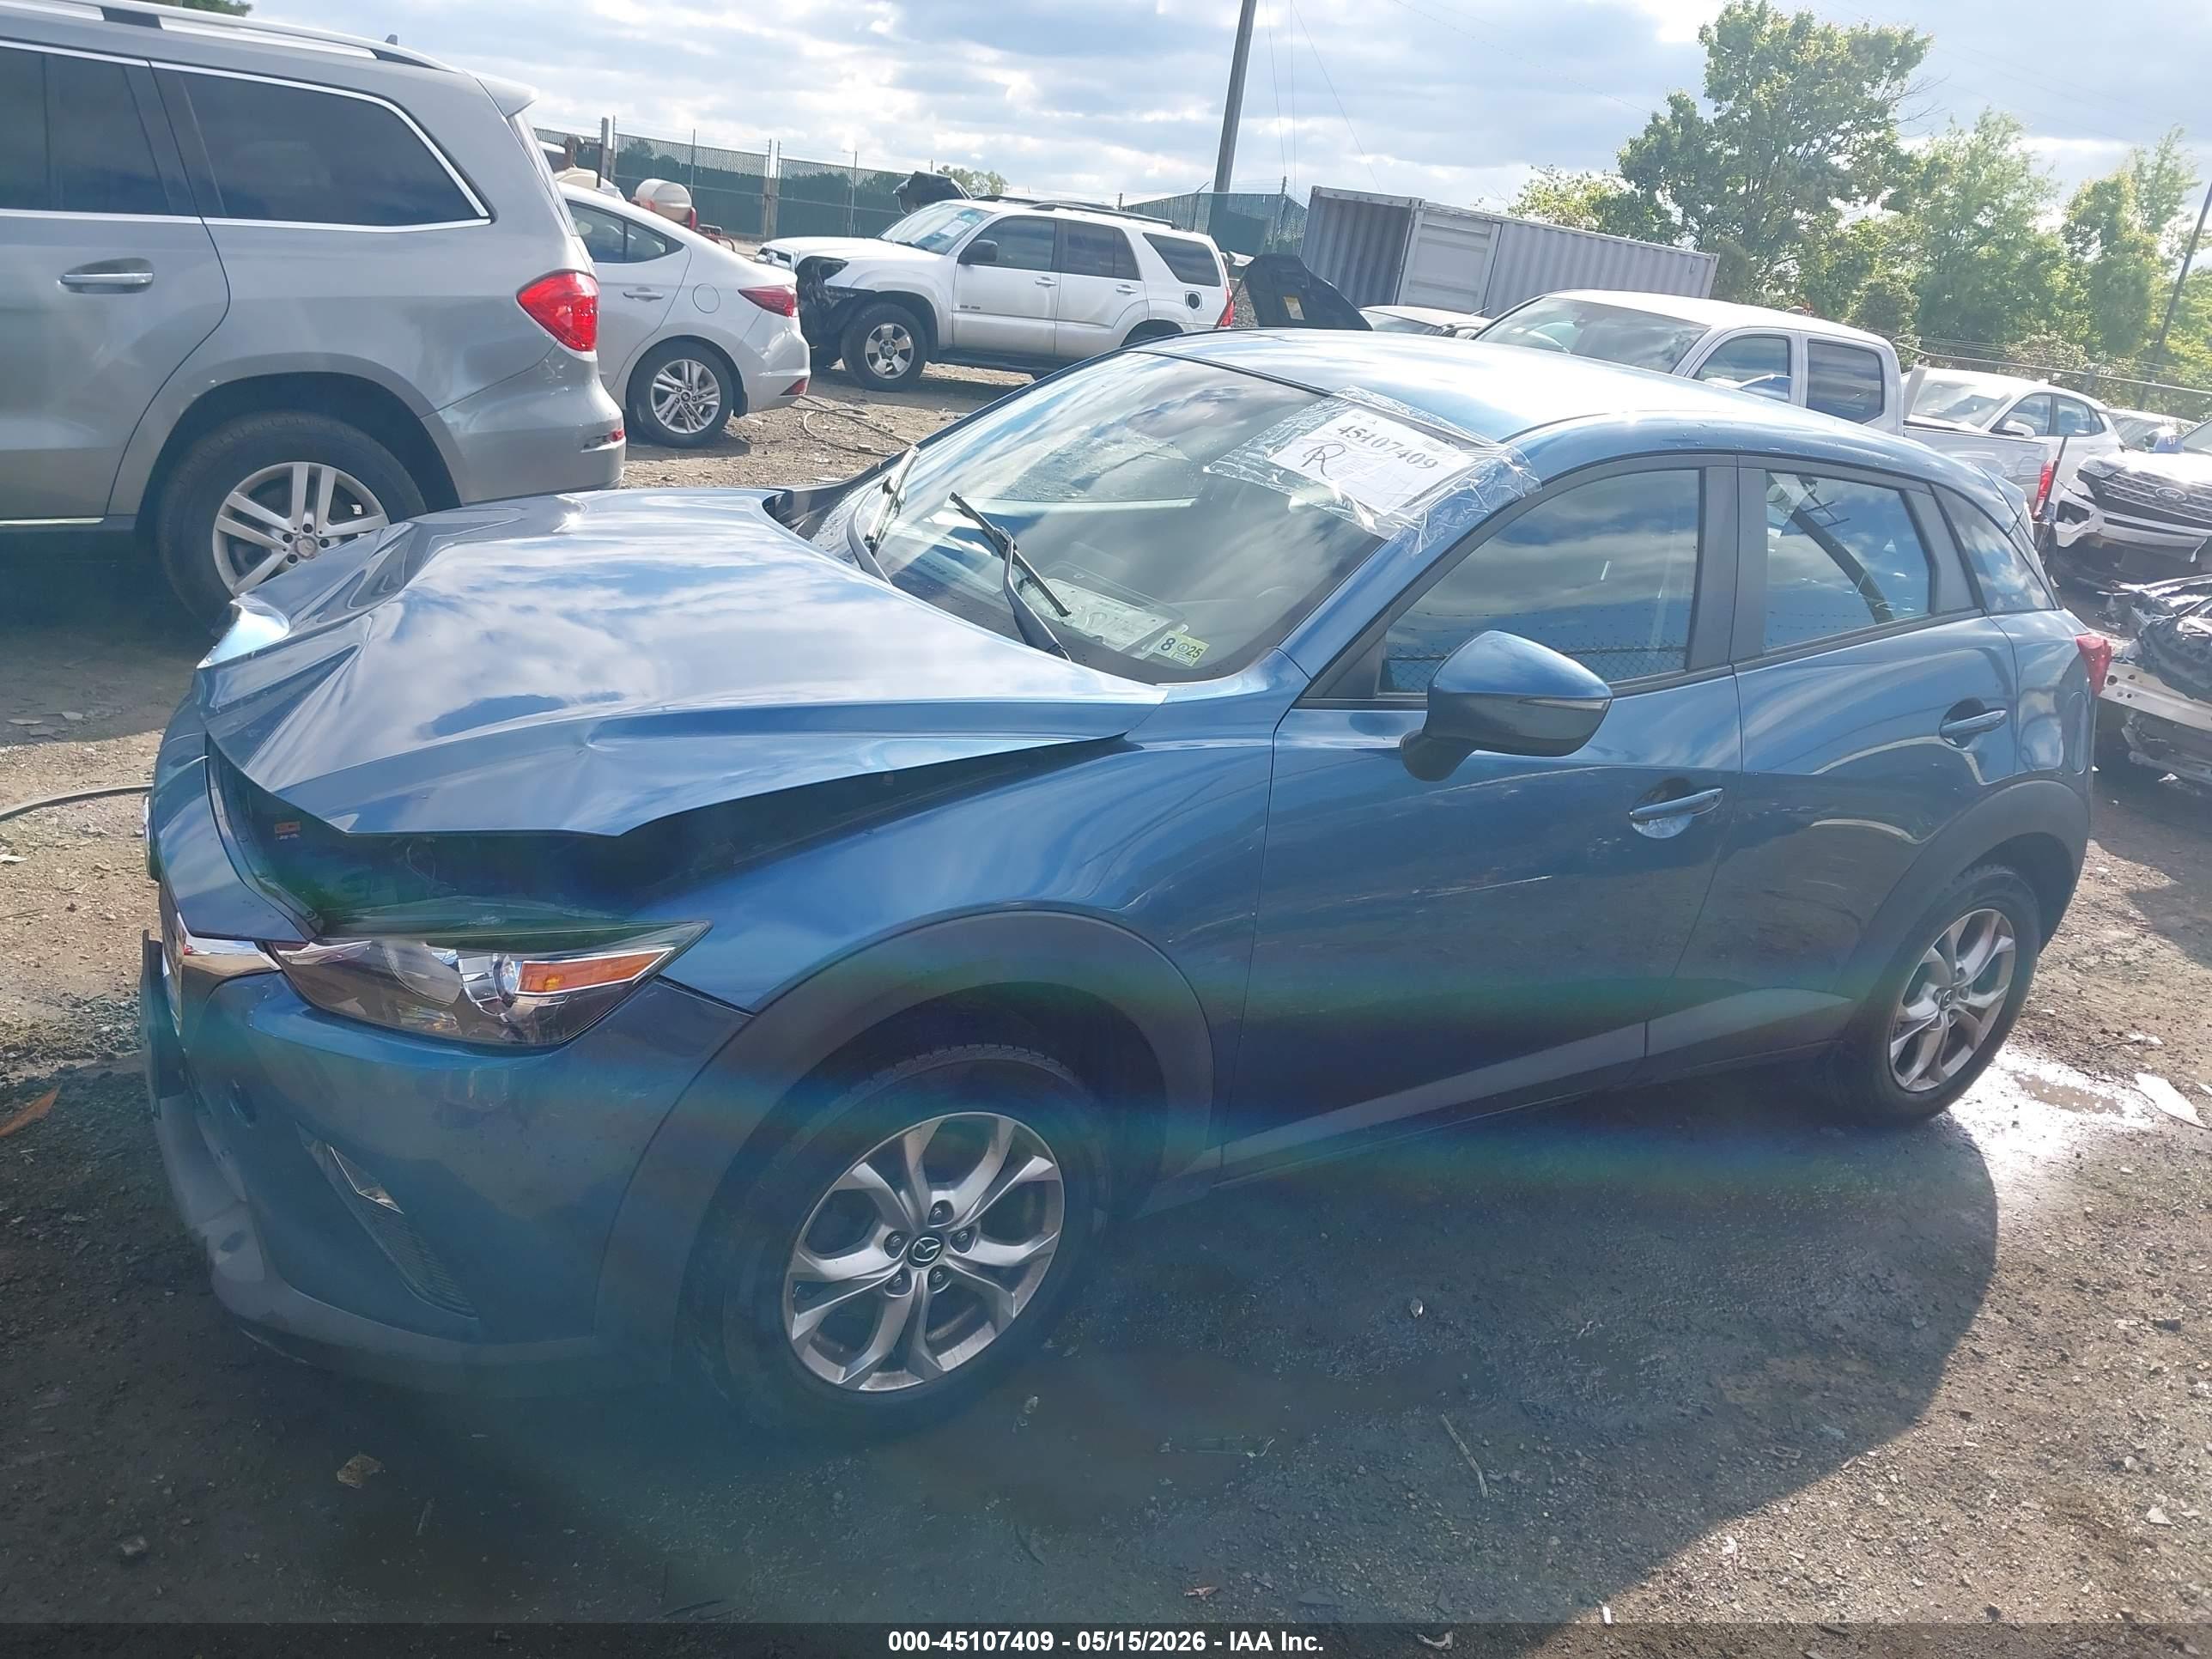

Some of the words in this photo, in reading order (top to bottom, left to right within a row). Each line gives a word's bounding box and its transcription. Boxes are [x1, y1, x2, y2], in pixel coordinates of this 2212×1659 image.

[1301, 443, 1346, 480] R
[1337, 425, 1439, 469] 45107409
[1160, 638, 1176, 651] 8
[1185, 646, 1203, 659] 25
